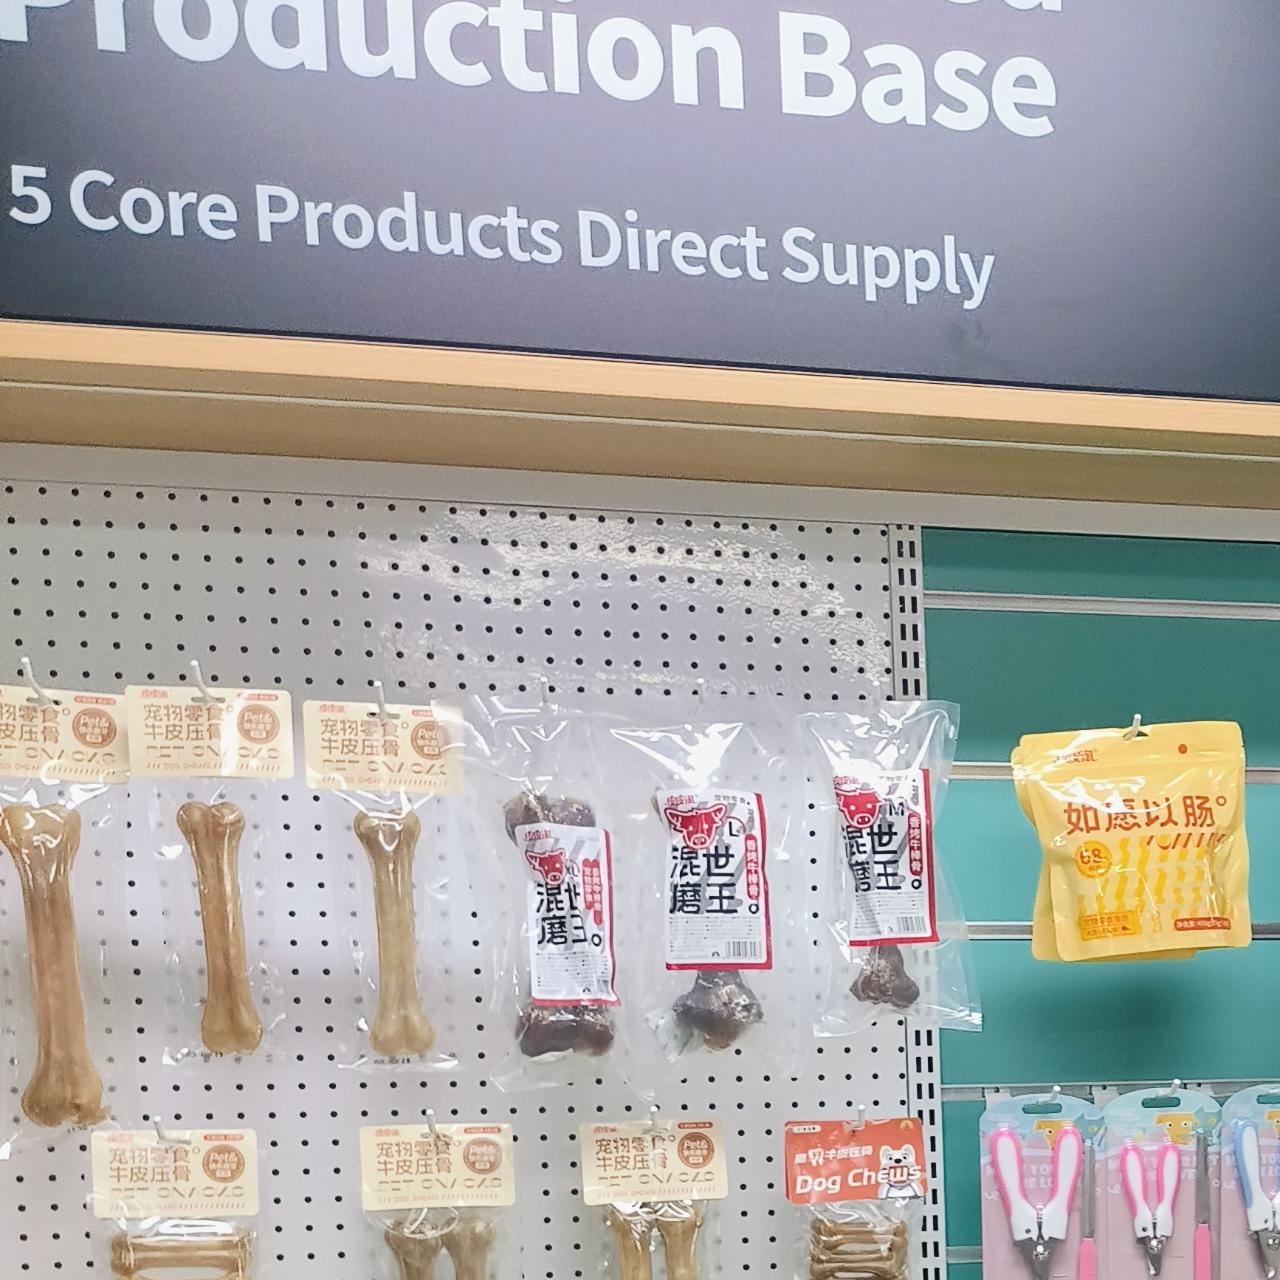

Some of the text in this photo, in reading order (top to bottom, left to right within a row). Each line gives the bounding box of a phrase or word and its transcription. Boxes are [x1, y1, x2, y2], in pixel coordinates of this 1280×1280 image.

[778, 10, 1057, 137] Base
[8, 164, 995, 311] 5 Core Products Direct Supply
[670, 845, 735, 878] 混世
[795, 1166, 921, 1194] Dog Chews
